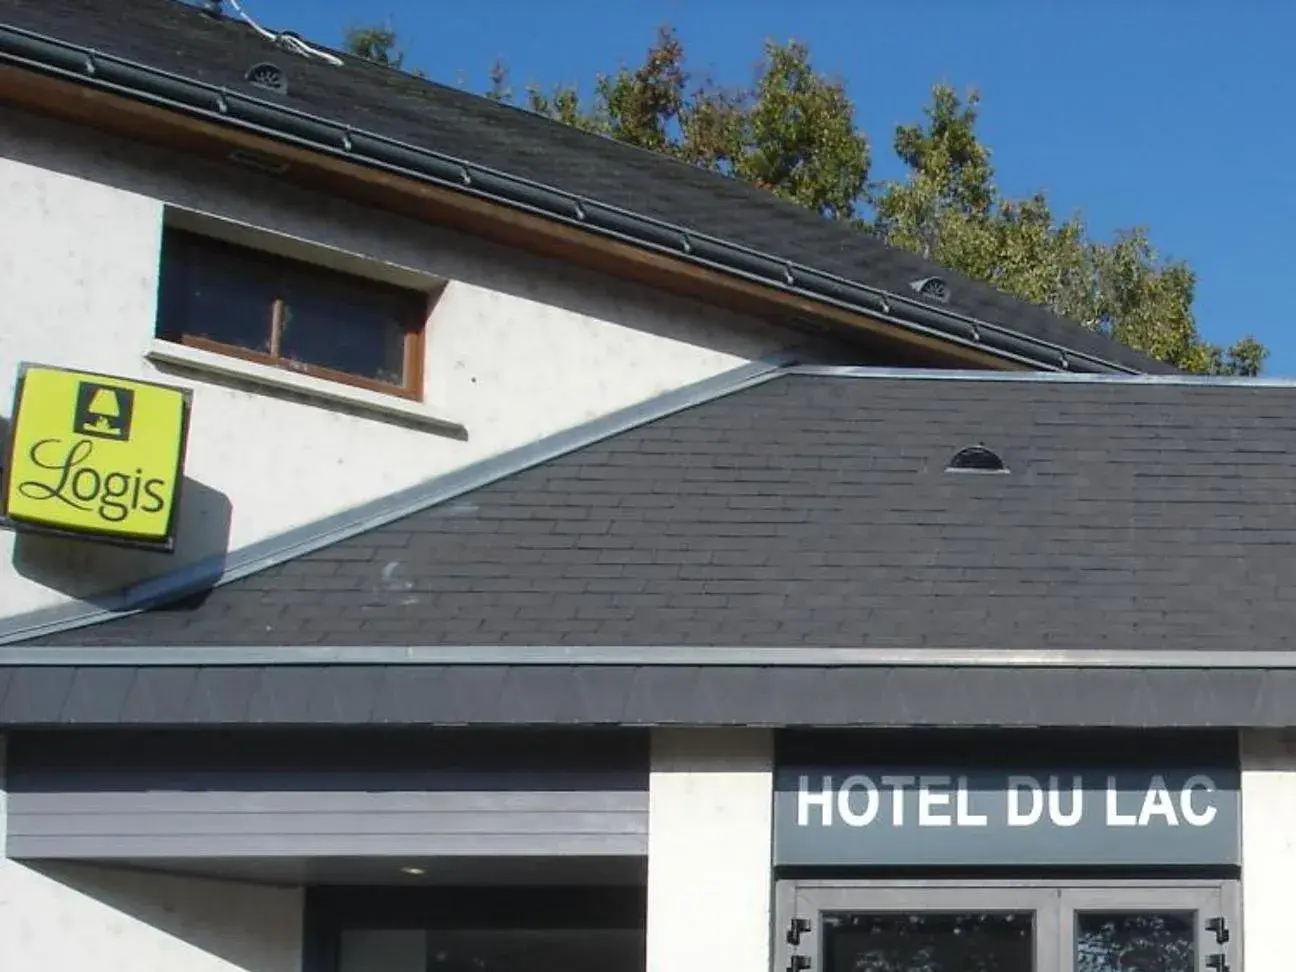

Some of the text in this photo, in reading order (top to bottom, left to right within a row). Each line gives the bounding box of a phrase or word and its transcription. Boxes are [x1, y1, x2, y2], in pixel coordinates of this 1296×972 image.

[18, 438, 166, 522] Logis
[797, 774, 1218, 828] HOTEL DU LAC
